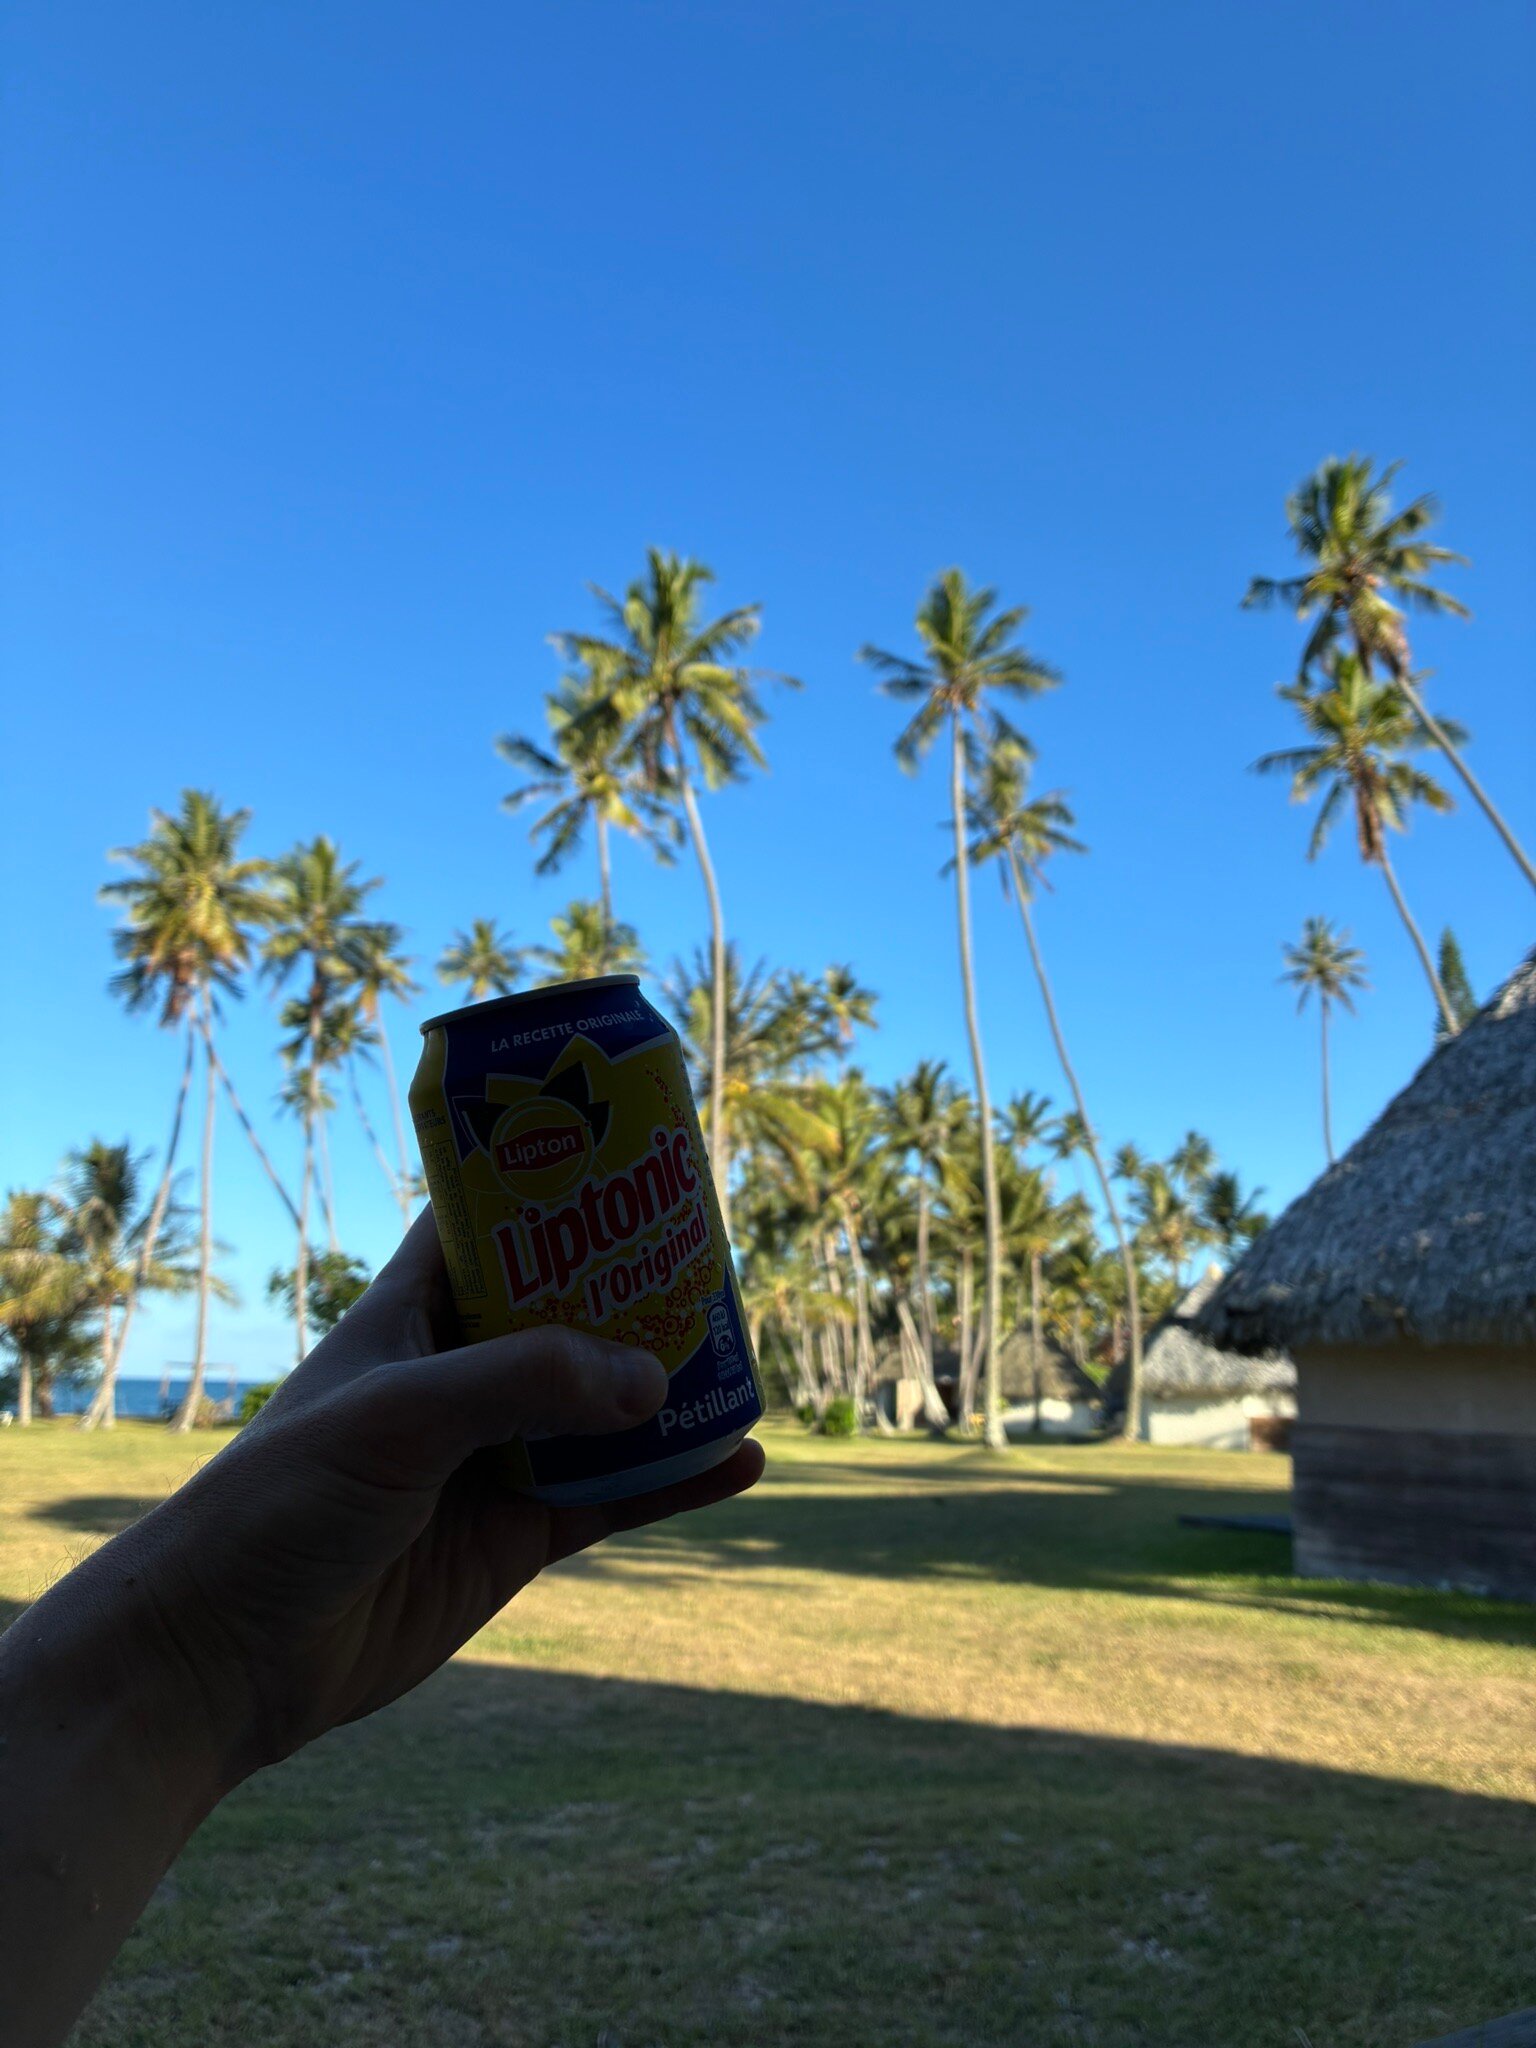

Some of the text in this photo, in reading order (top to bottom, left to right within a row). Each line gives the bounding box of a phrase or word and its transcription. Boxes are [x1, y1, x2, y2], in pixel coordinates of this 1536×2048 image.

[490, 1009, 645, 1053] LA RECETTE ORIGINALE
[503, 1133, 578, 1166] Lipton
[495, 1129, 698, 1305] Liptonic
[589, 1203, 708, 1319] l'Original
[656, 1379, 755, 1437] Pétillant
